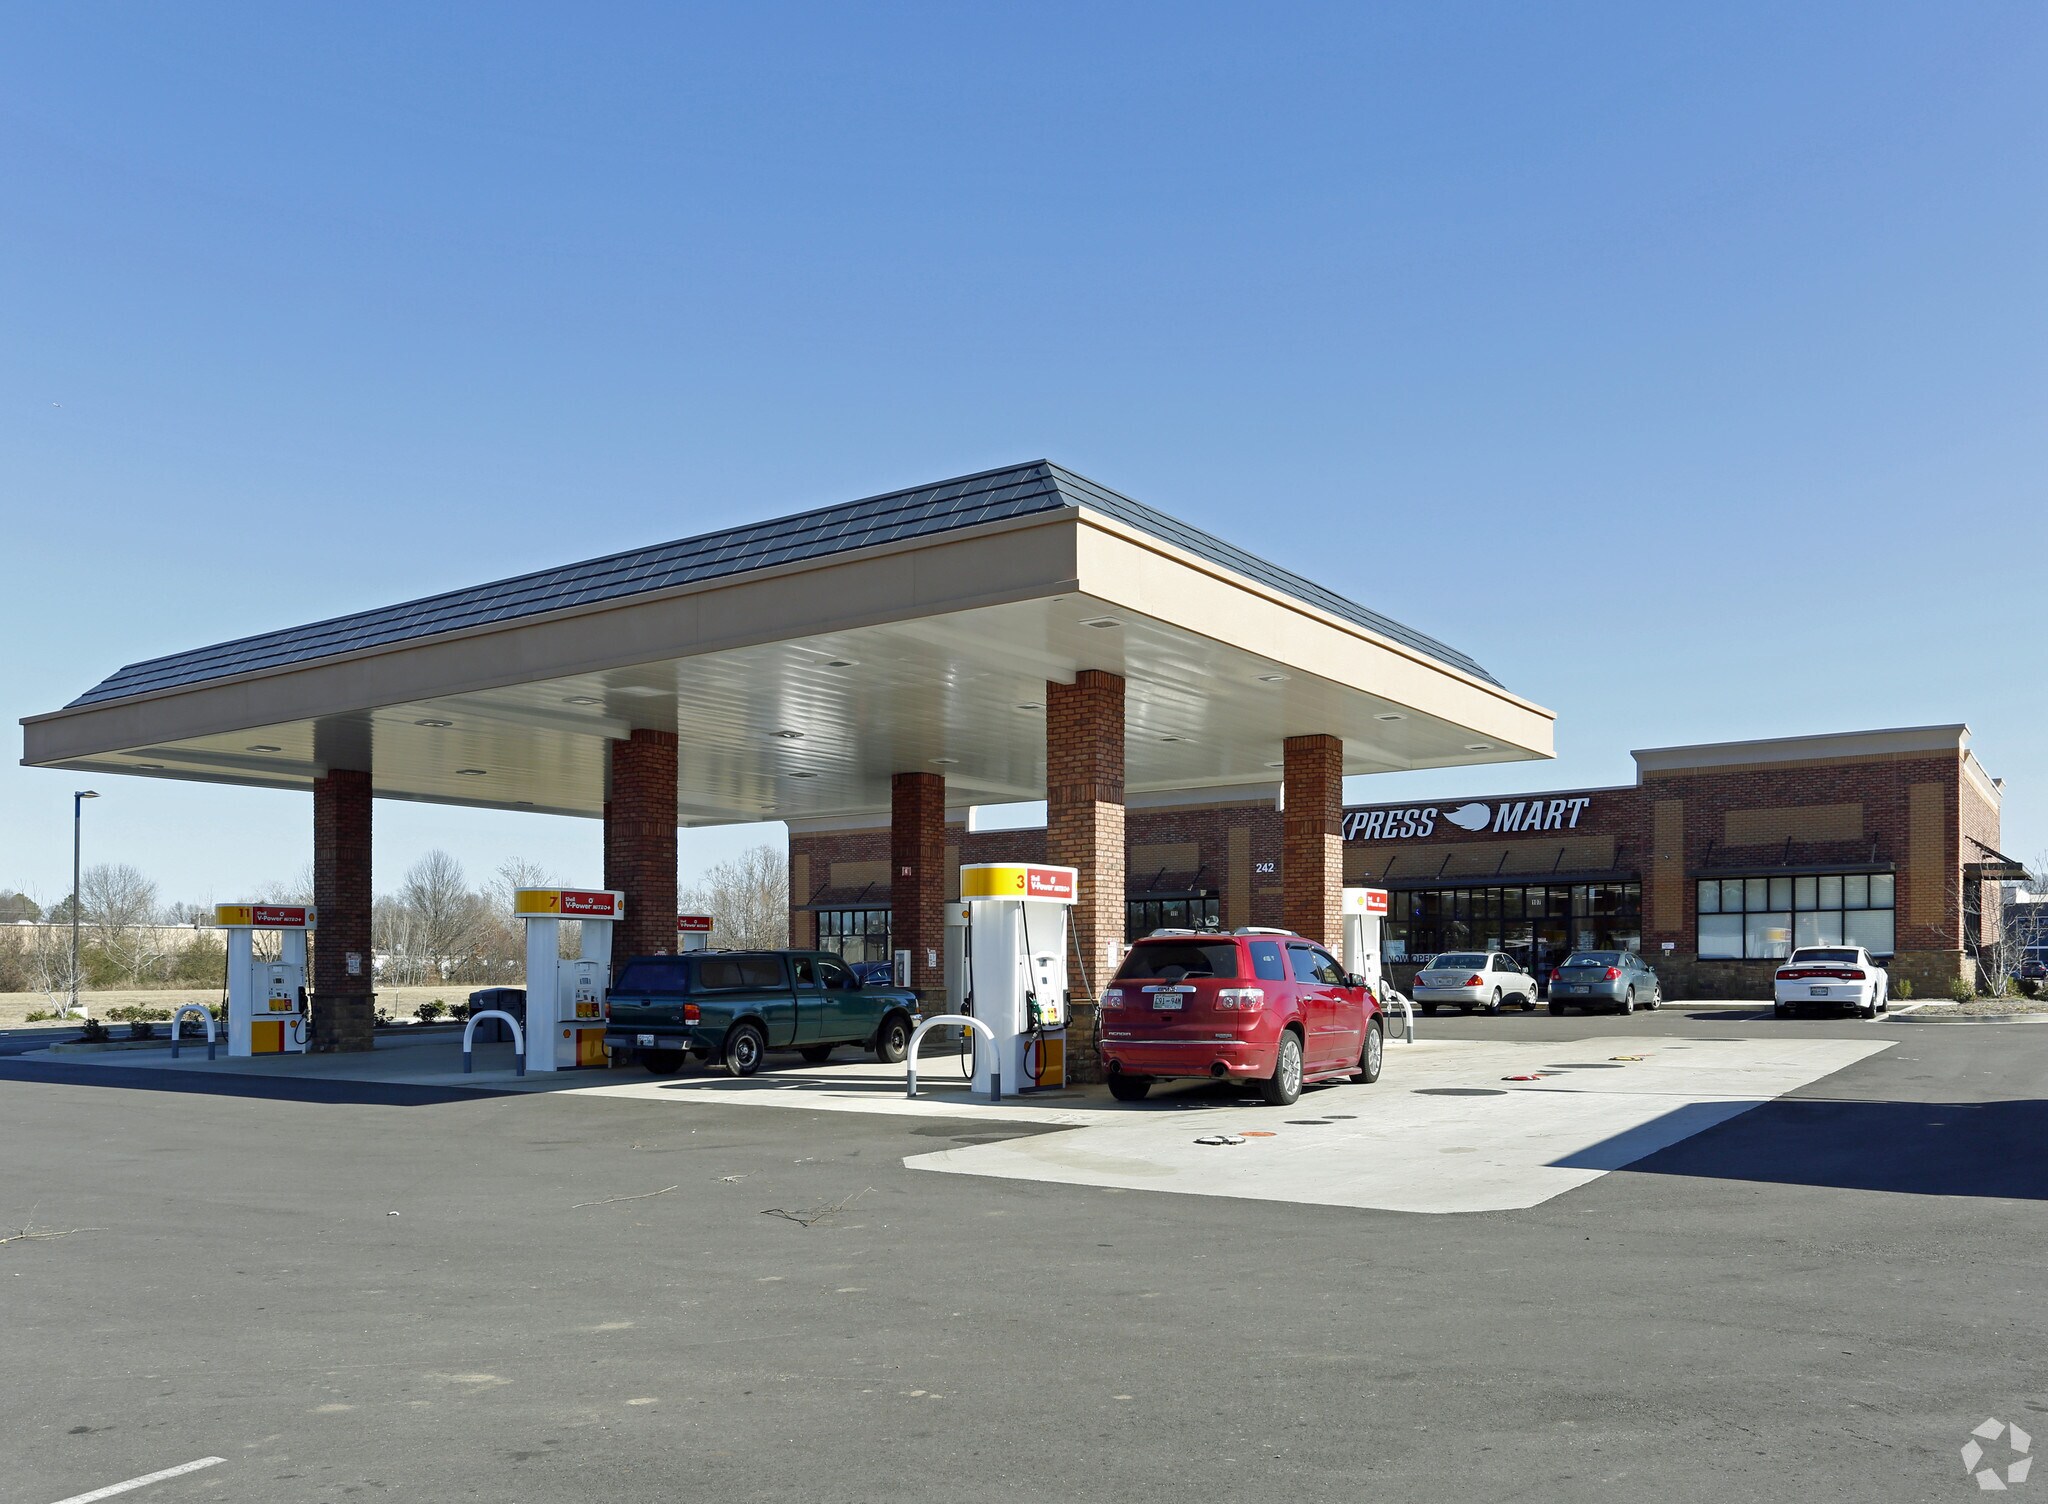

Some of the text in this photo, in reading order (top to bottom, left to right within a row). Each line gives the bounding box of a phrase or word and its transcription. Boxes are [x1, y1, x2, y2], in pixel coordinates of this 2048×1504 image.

[1493, 798, 1590, 833] MART
[1256, 863, 1274, 873] 242
[1016, 875, 1025, 889] 3
[549, 897, 558, 907] 7
[238, 908, 250, 918] 11
[1388, 954, 1409, 962] NOW
